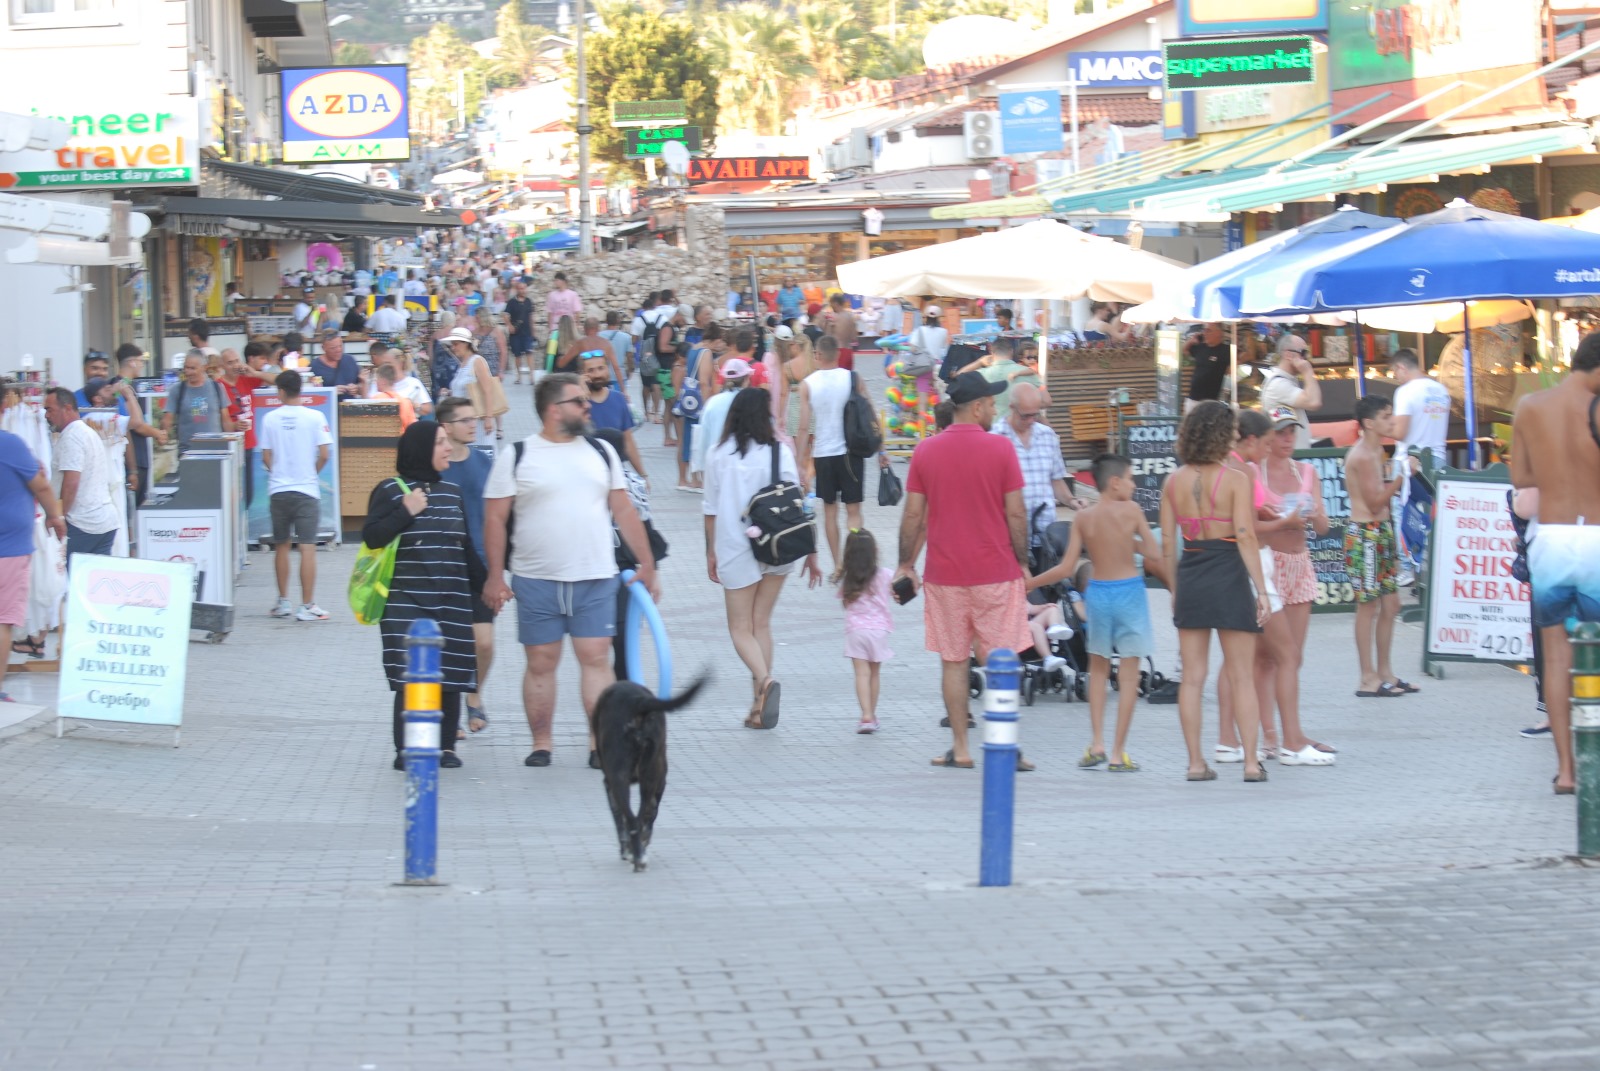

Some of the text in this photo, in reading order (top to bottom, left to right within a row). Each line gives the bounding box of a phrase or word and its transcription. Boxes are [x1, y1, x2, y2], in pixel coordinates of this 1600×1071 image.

[1167, 48, 1312, 78] supermarket
[299, 93, 391, 115] AZDA
[638, 128, 684, 140] CASH
[55, 136, 184, 168] travel
[312, 144, 383, 158] AVM
[38, 173, 78, 184] your
[81, 171, 119, 181] best
[121, 170, 153, 182] day
[1131, 457, 1178, 475] EFES
[1445, 495, 1499, 512] Sultan
[1456, 516, 1490, 532] BBQ
[1454, 554, 1513, 577] SHIS
[1452, 579, 1531, 601] KEBAB
[1481, 605, 1504, 613] WITH
[88, 619, 165, 638] STERLING
[97, 640, 151, 657] SILVER
[1481, 634, 1522, 655] 420
[77, 657, 169, 677] JEWELLERY
